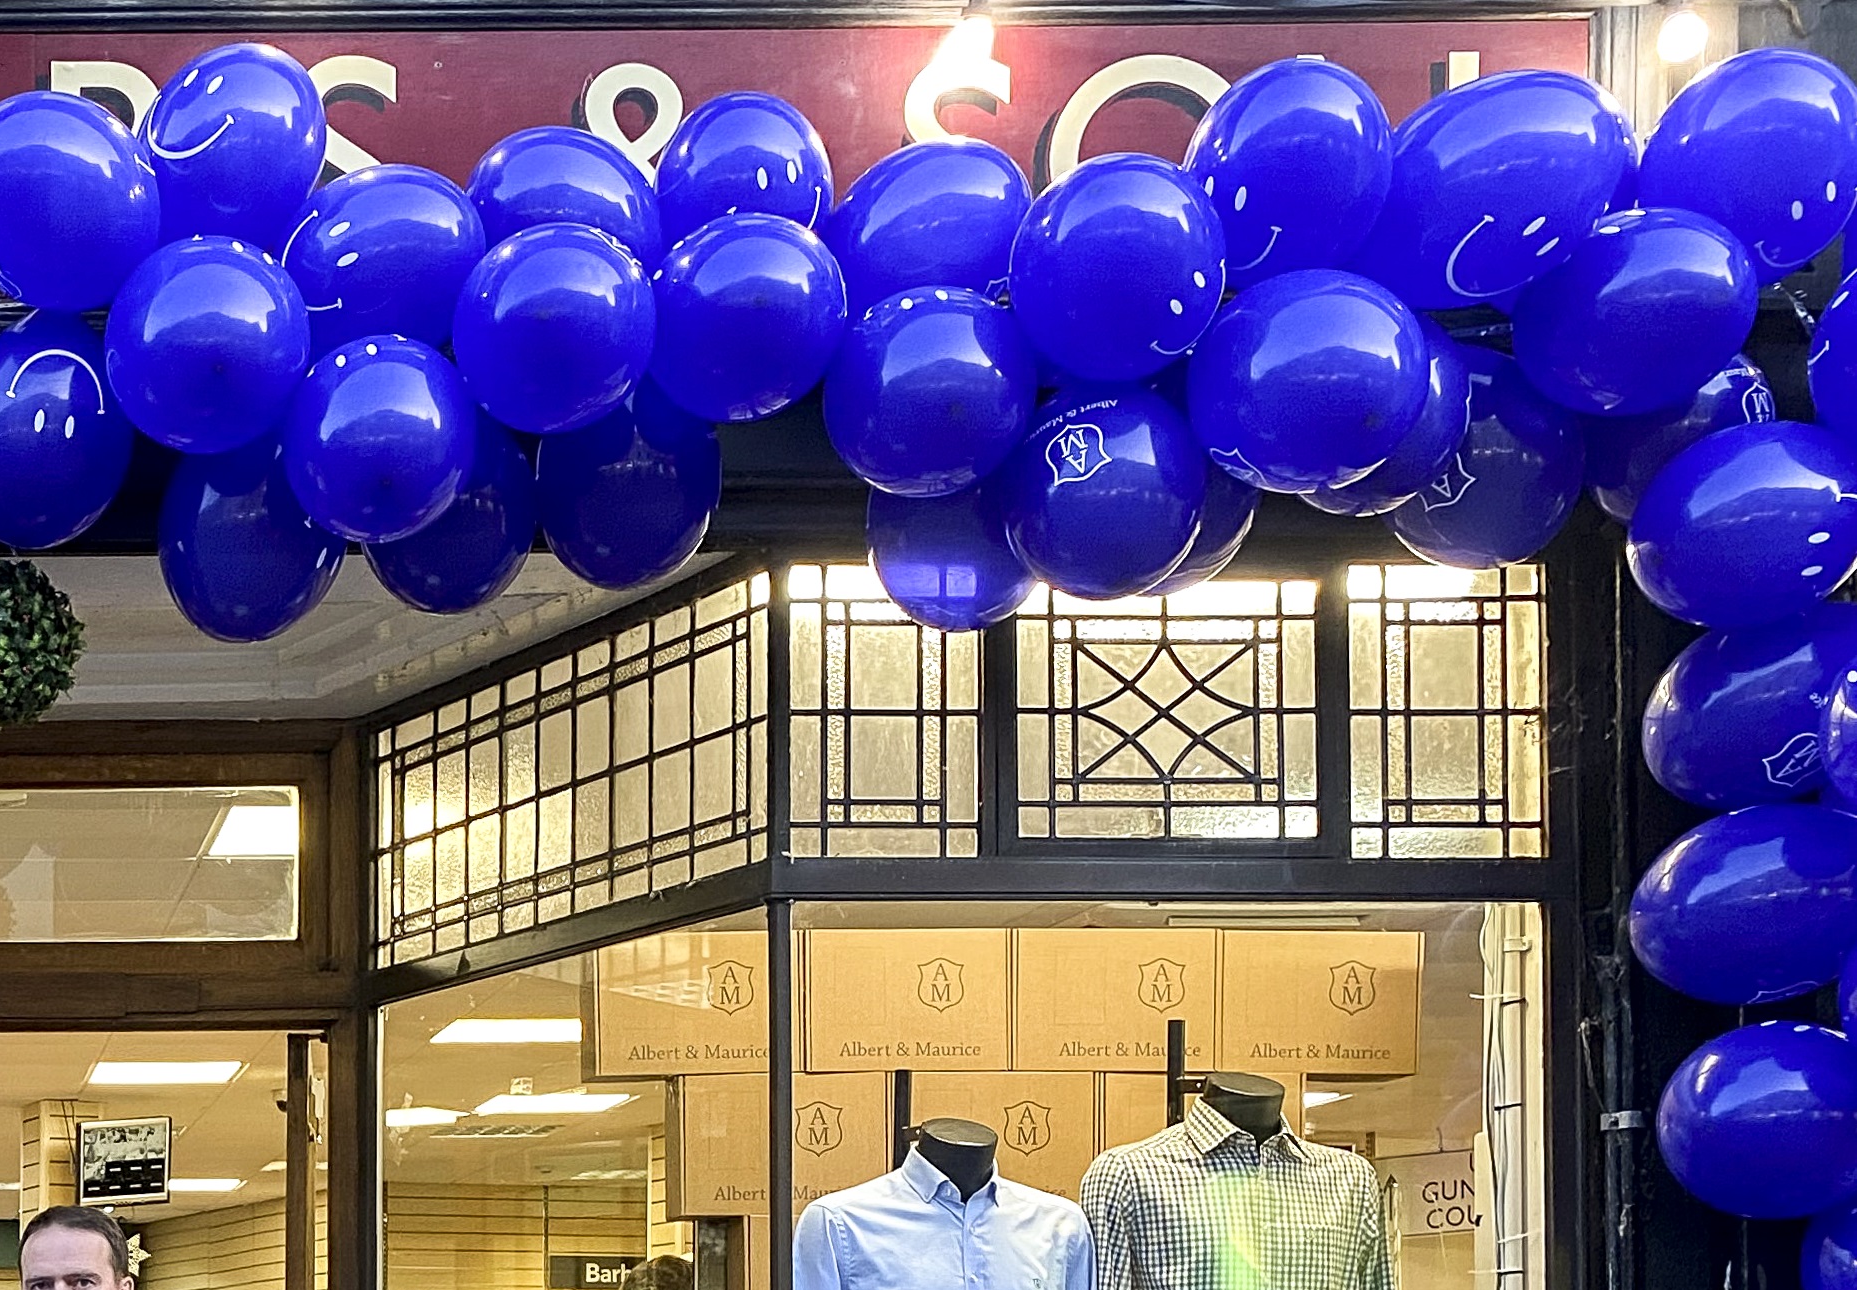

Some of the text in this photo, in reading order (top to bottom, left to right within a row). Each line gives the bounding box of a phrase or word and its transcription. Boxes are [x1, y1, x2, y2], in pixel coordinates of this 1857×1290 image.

[583, 62, 684, 187] &
[627, 1044, 681, 1061] Albert
[685, 1045, 700, 1060] &
[840, 1041, 982, 1058] Albert & Maurice
[1059, 1041, 1201, 1058] Albert & Mace
[1250, 1043, 1391, 1060] Albert & Maurice
[714, 1186, 766, 1202] Albert
